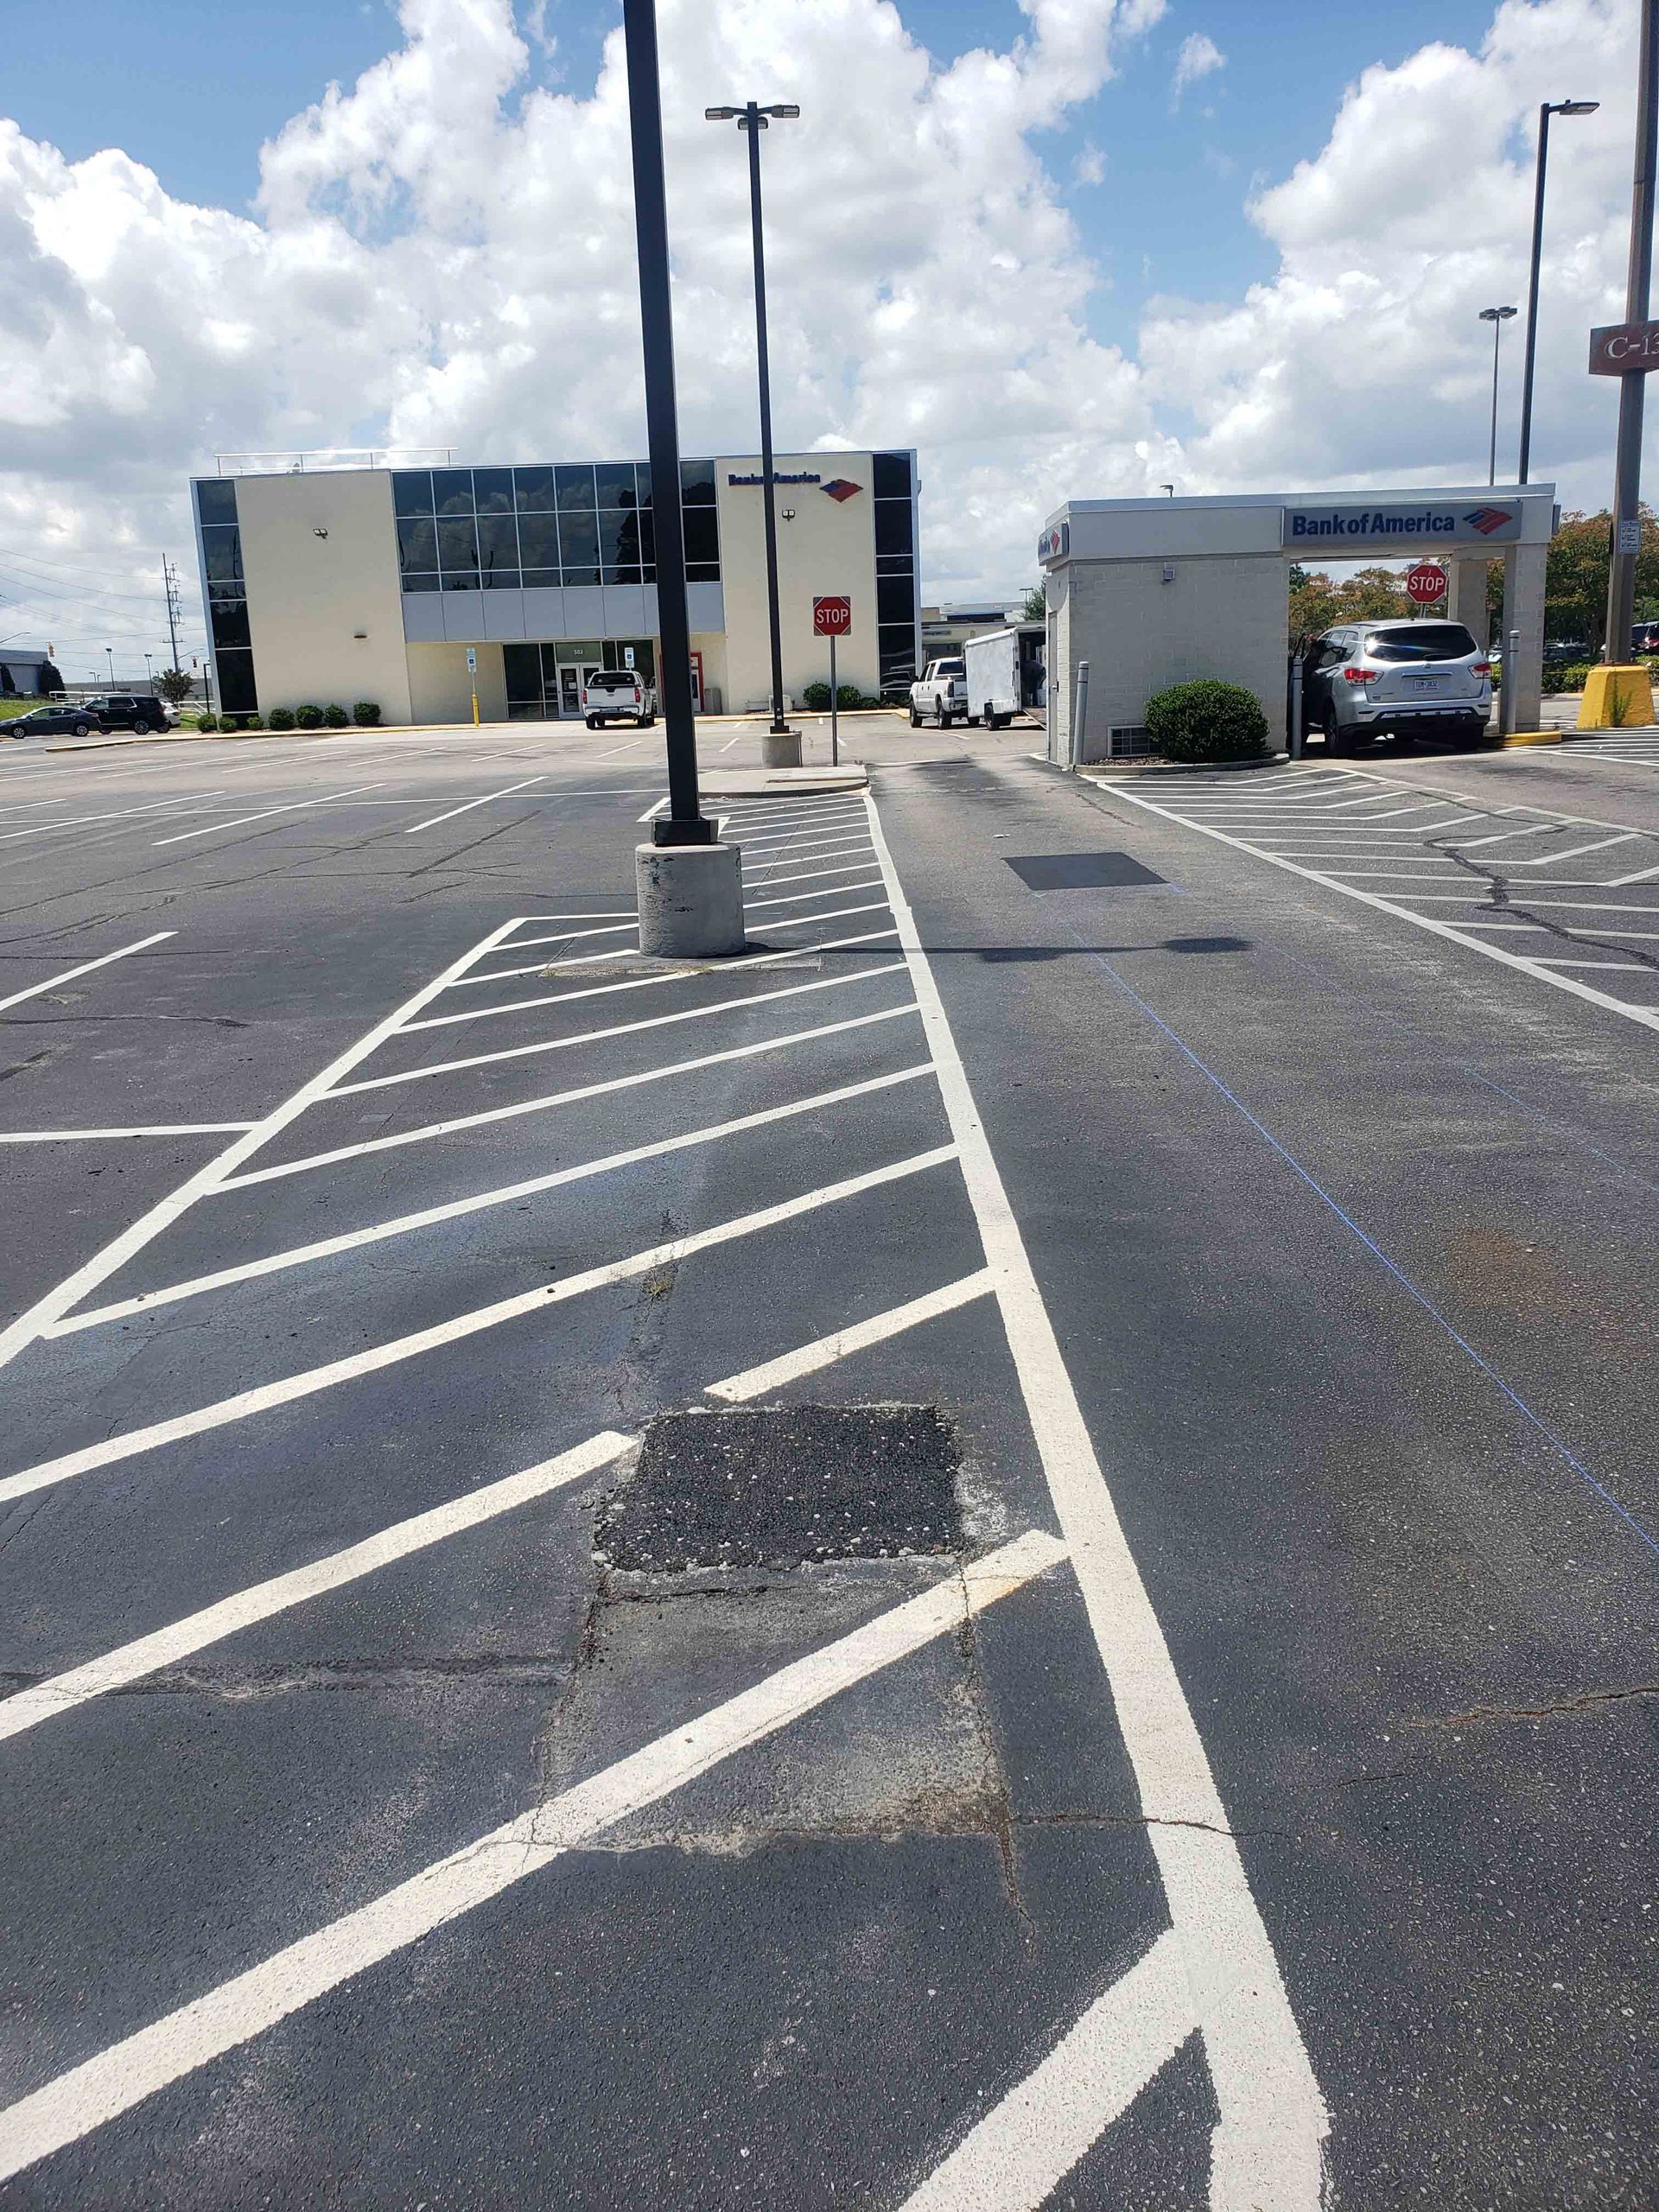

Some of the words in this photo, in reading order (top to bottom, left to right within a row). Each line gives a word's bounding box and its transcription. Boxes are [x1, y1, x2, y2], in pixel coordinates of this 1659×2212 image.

[1293, 514, 1345, 536] Bank
[1370, 512, 1455, 533] America
[1409, 576, 1445, 591] STOP
[817, 608, 849, 624] STOP
